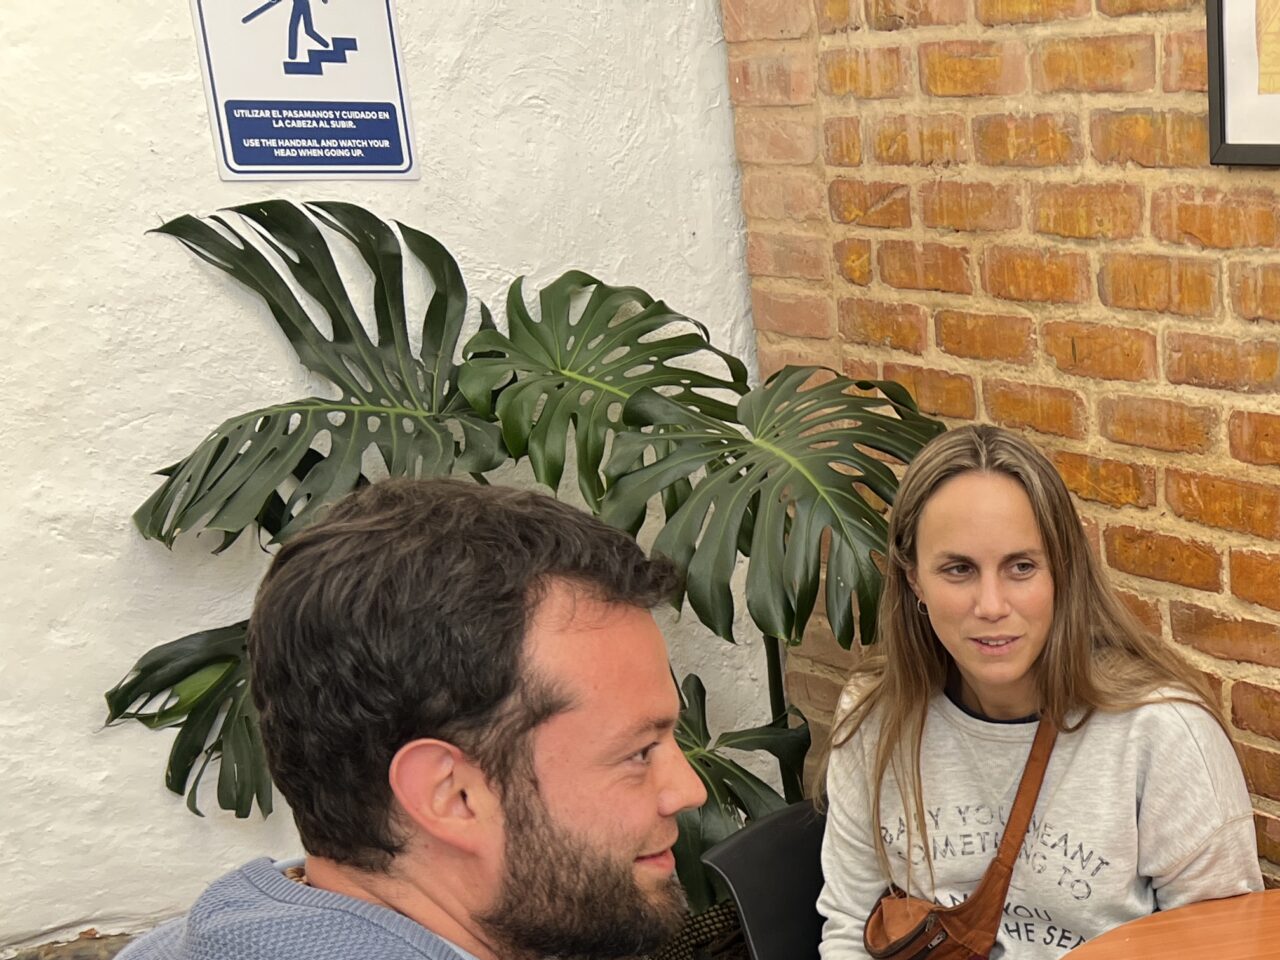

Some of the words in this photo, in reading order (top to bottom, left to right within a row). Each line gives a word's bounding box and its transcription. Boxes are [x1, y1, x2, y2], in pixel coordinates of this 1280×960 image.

[233, 109, 271, 118] UTILIZAR
[271, 109, 282, 118] EL
[282, 110, 334, 119] PASAMANOS
[334, 110, 340, 119] Y
[341, 110, 377, 119] CUIDADO
[378, 111, 390, 119] EN
[272, 120, 284, 128] LA
[285, 120, 318, 128] CABEZA
[319, 120, 330, 128] AL
[330, 120, 356, 129] SUBIR.
[243, 138, 260, 147] USE
[260, 138, 277, 147] THE
[278, 139, 319, 148] HANDRAIL
[321, 139, 338, 148] AND
[338, 139, 368, 148] WATCH
[368, 139, 390, 148] YOUR
[274, 148, 297, 157] HEAD
[297, 148, 324, 157] WHEN
[324, 149, 350, 157] GOING
[351, 149, 364, 157] UP.
[1057, 866, 1092, 900] TO
[1004, 921, 1035, 942] HE
